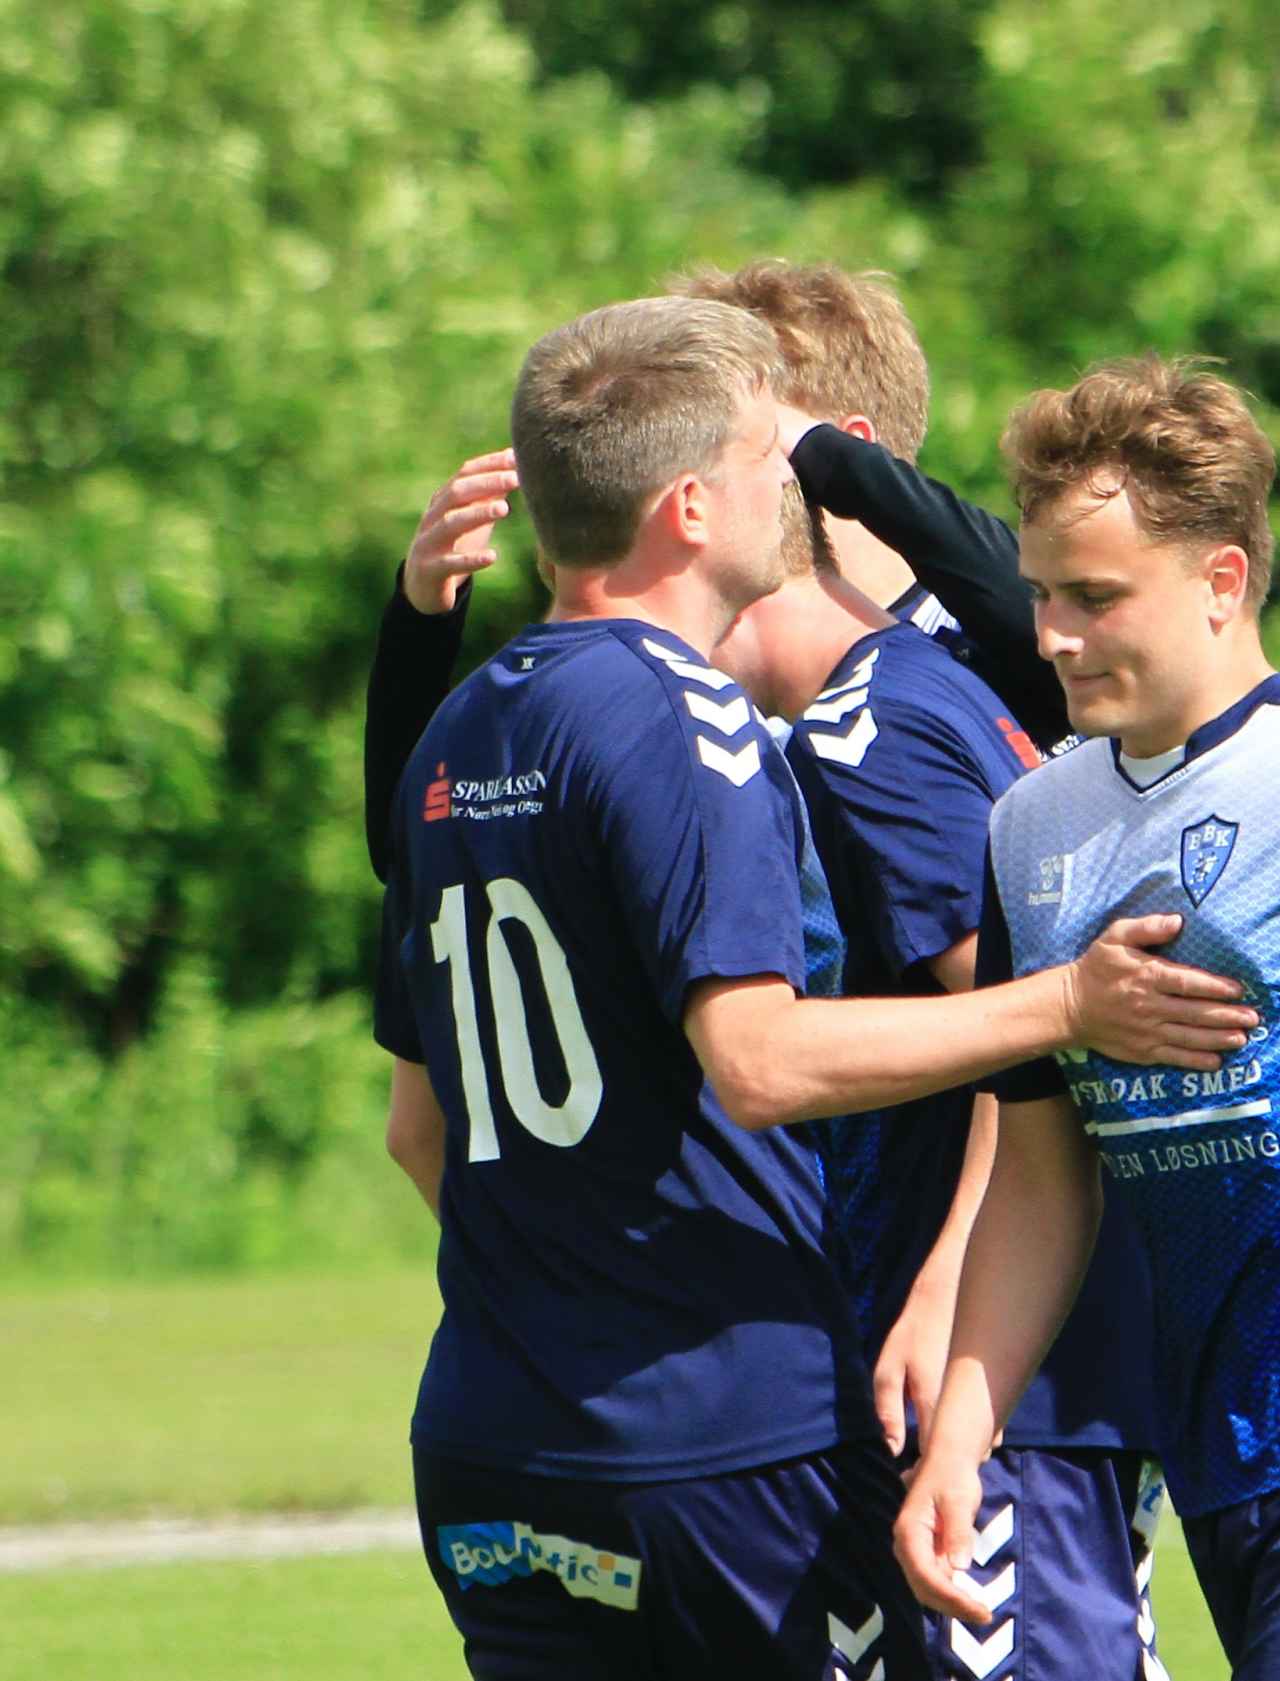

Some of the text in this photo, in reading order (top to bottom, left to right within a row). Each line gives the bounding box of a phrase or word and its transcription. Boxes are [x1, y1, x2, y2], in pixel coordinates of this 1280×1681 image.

[1188, 823, 1232, 851] BBK
[429, 877, 604, 1164] 10
[1182, 1058, 1262, 1098] SMED
[1149, 1131, 1280, 1173] LØSNING
